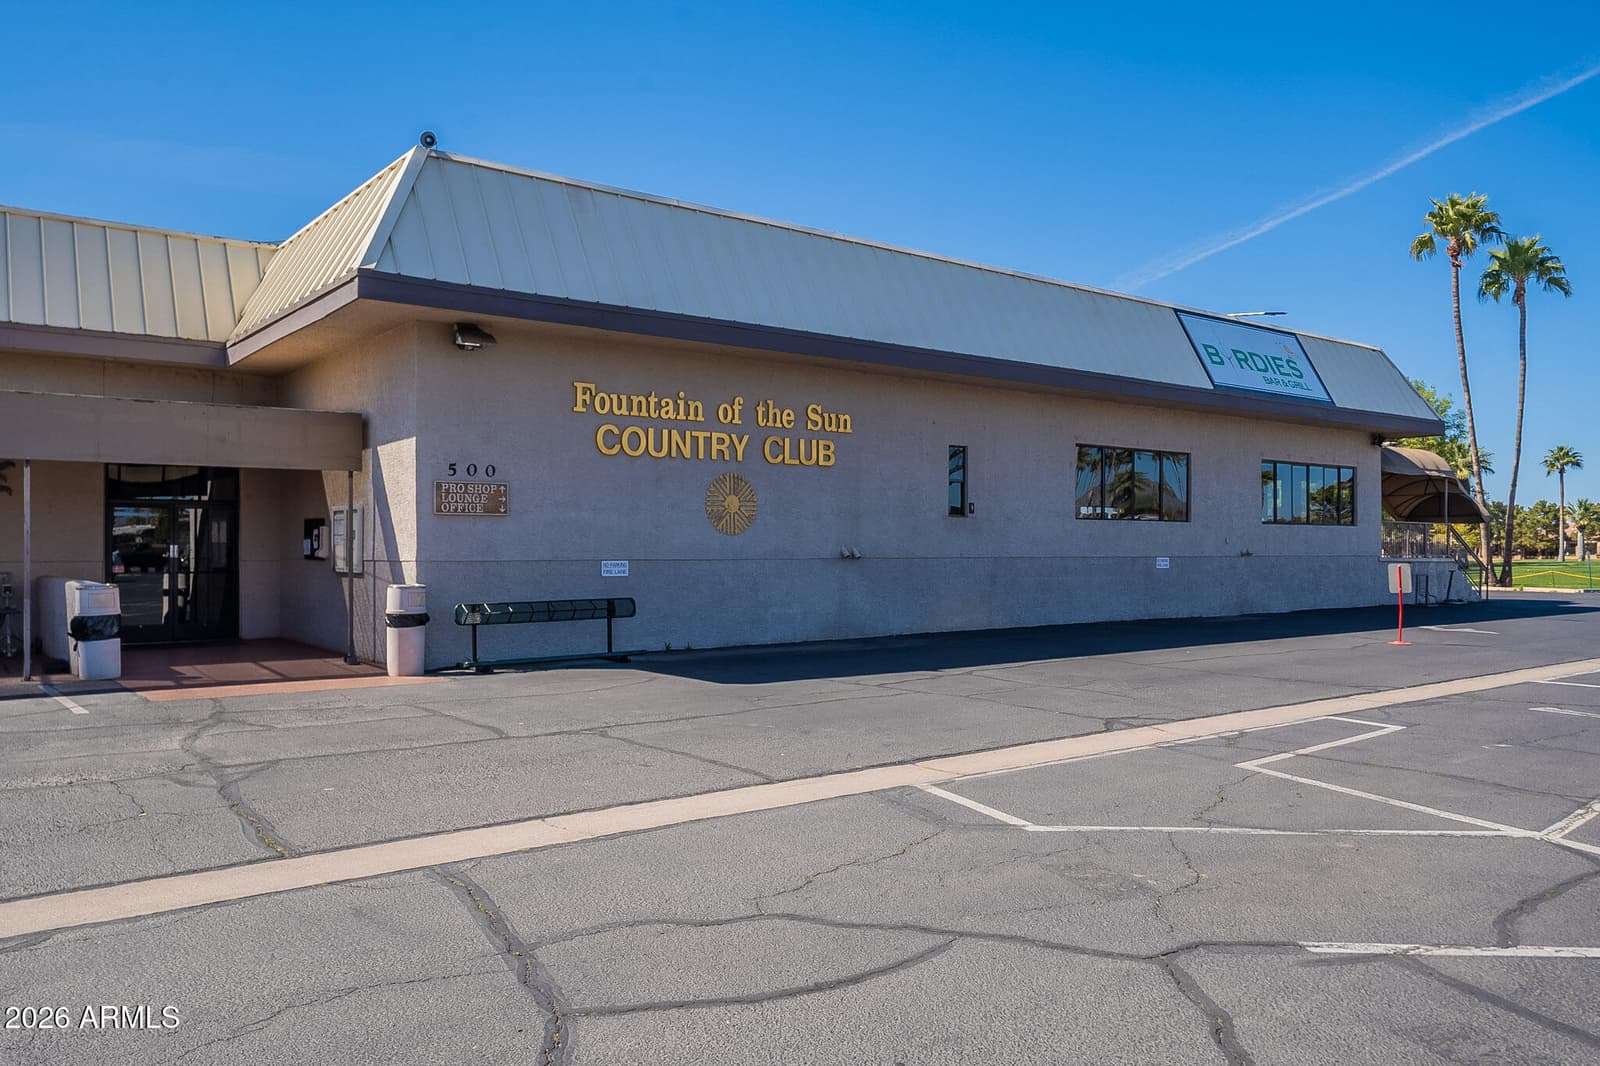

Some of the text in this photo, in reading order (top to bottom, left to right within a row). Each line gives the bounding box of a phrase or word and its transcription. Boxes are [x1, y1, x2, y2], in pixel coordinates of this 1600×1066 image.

[1263, 375, 1282, 387] BAR
[1287, 380, 1312, 391] GRILL
[573, 380, 853, 433] Fountain of the Sun
[595, 423, 836, 467] COUNTRY CLUB
[447, 462, 496, 478] 500
[441, 483, 497, 494] PRO SHOP
[441, 493, 489, 504] LOUNGE
[441, 502, 484, 513] OFFICE
